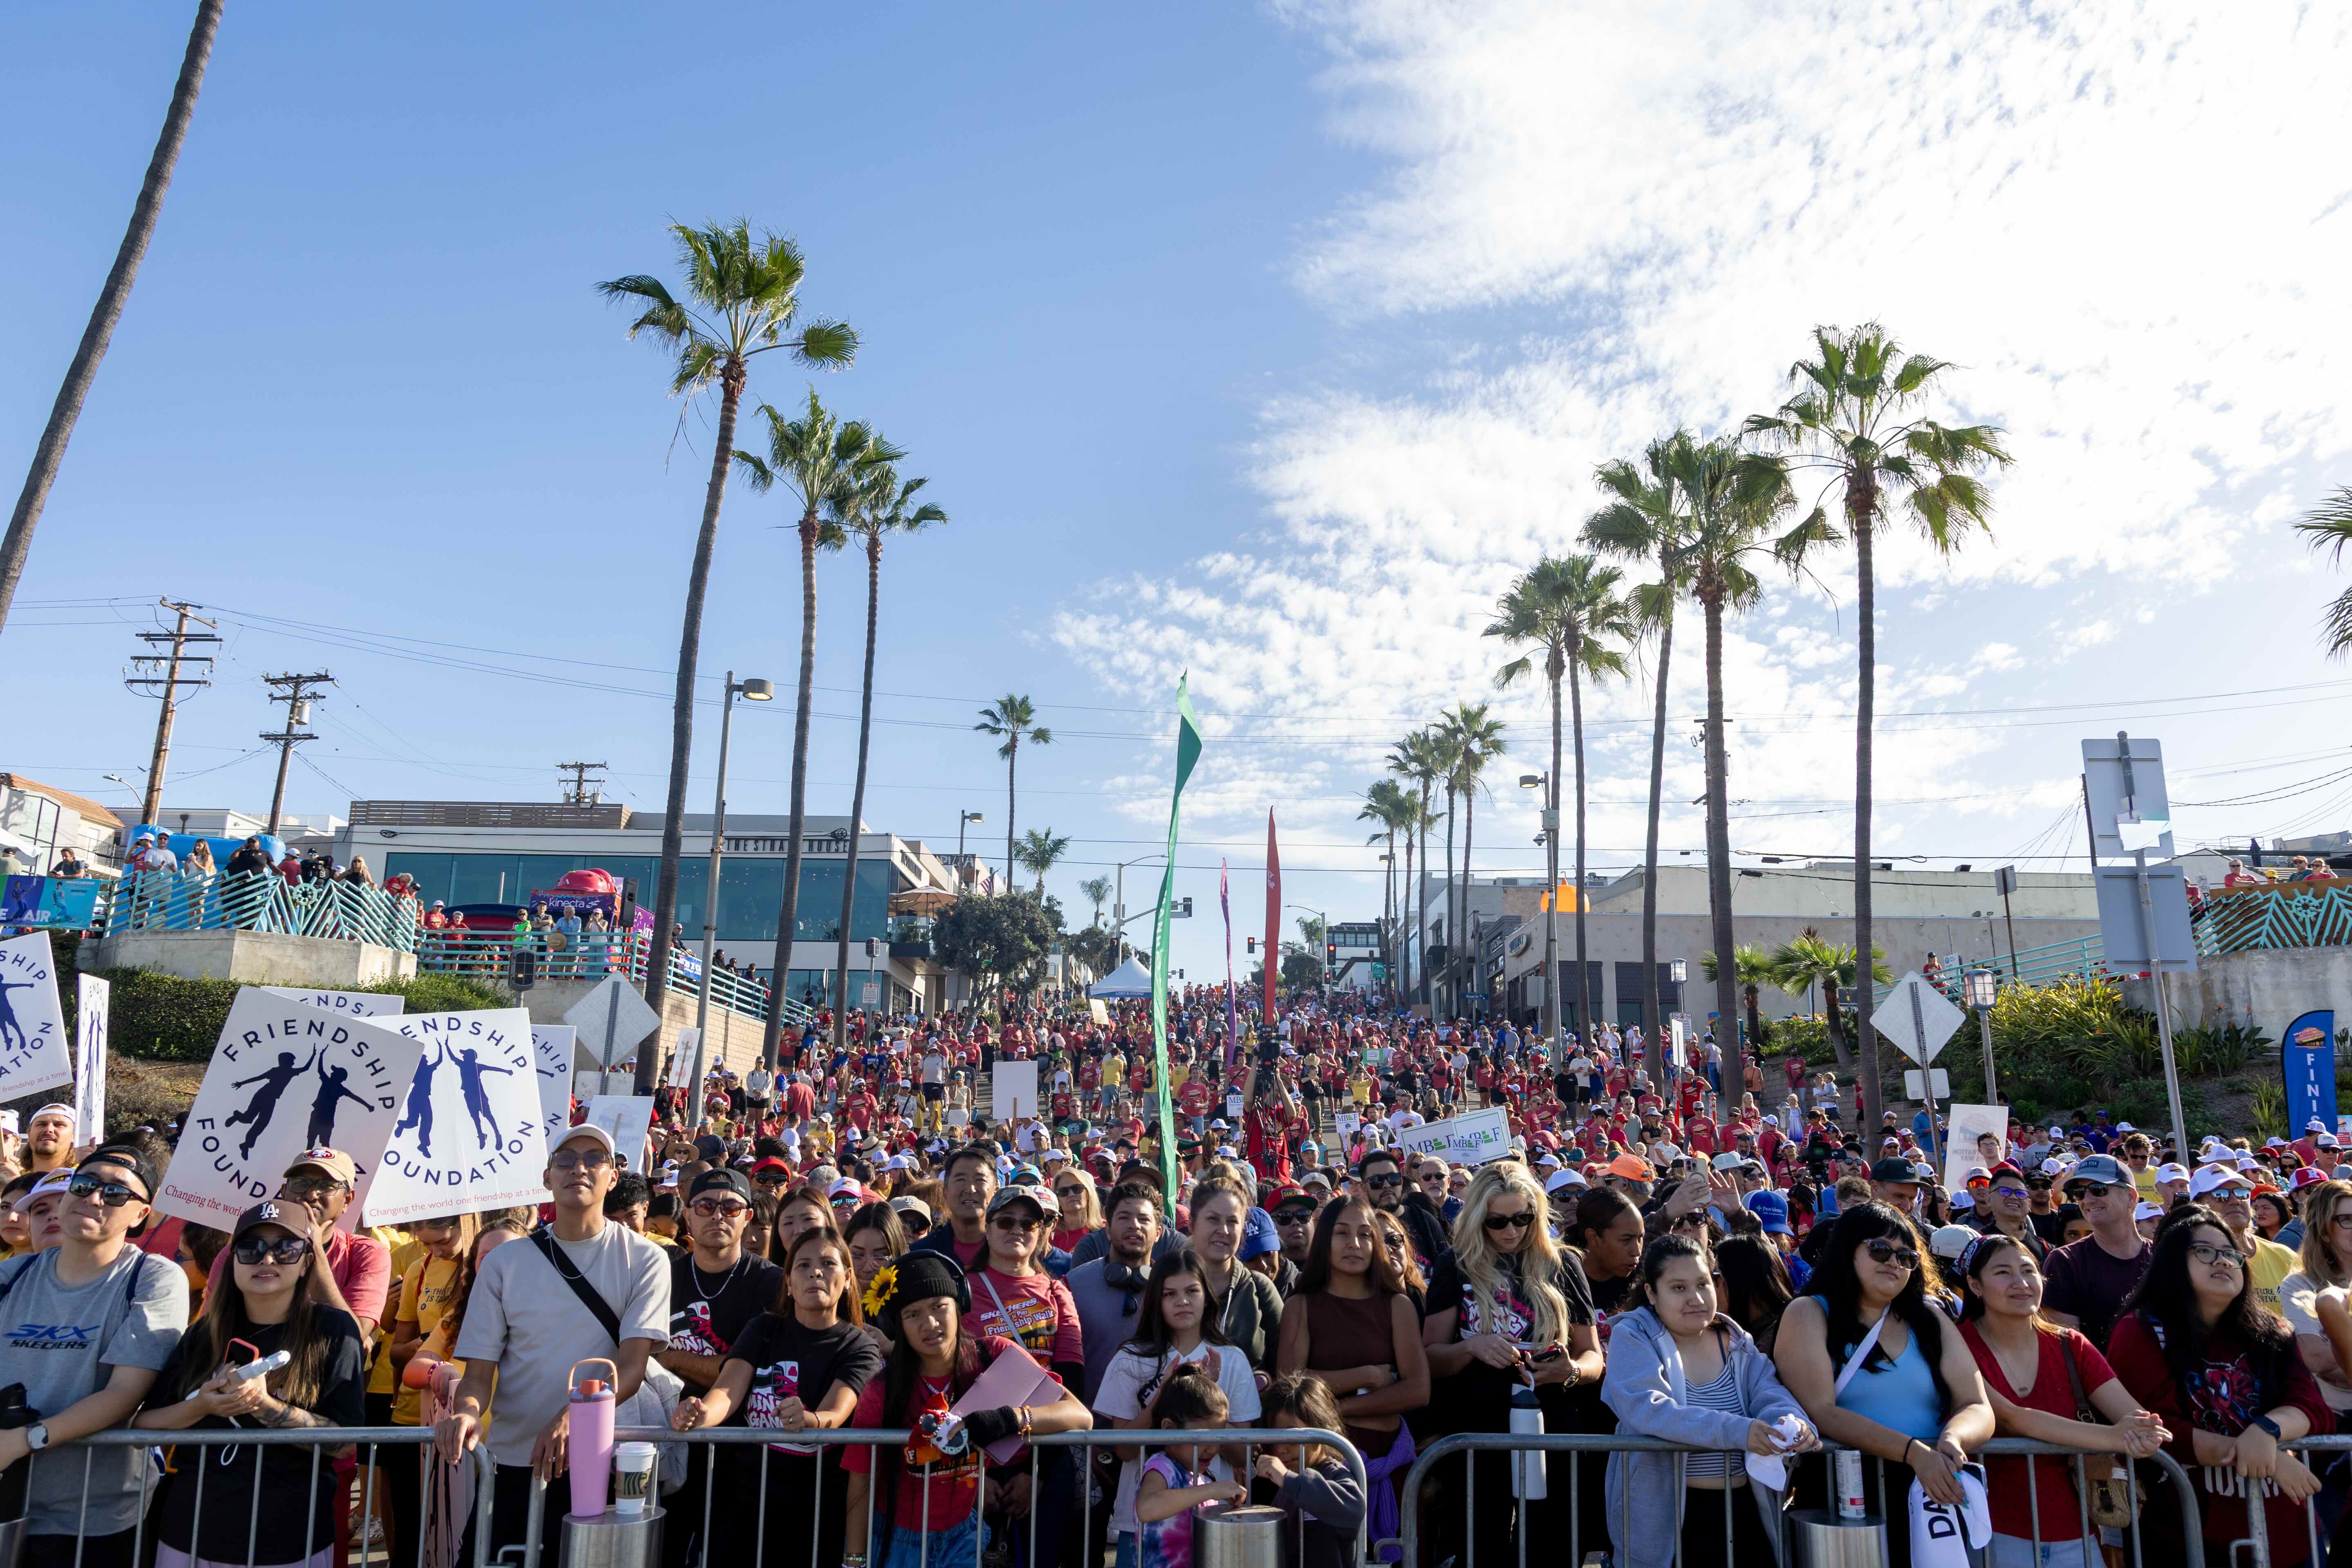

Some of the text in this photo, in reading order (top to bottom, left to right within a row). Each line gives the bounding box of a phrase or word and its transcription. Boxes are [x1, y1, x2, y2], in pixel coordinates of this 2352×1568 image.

[727, 839, 847, 852] THE STRA HOUSE
[549, 898, 585, 908] kinecta
[22, 909, 51, 922] AIR
[400, 1017, 527, 1069] ENDSHIP
[222, 1019, 395, 1109] FRIENDSHIP
[2, 1079, 36, 1092] friendship
[51, 1071, 66, 1079] time
[384, 1121, 535, 1186] OUNDATION
[1139, 1158, 1149, 1167] LA
[2306, 1169, 2321, 1179] R
[165, 1184, 206, 1208] Changing
[207, 1197, 221, 1210] the
[369, 1206, 410, 1217] Changing
[411, 1203, 426, 1211] the
[428, 1199, 453, 1209] world
[474, 1192, 513, 1203] friendship
[260, 1202, 279, 1219] LA
[980, 1298, 1037, 1321] SKEHERS
[3, 1323, 101, 1339] SKX
[987, 1310, 1054, 1336] Frienship Walk
[9, 1339, 90, 1349] SKECHERS
[1922, 1492, 1957, 1539] DA
